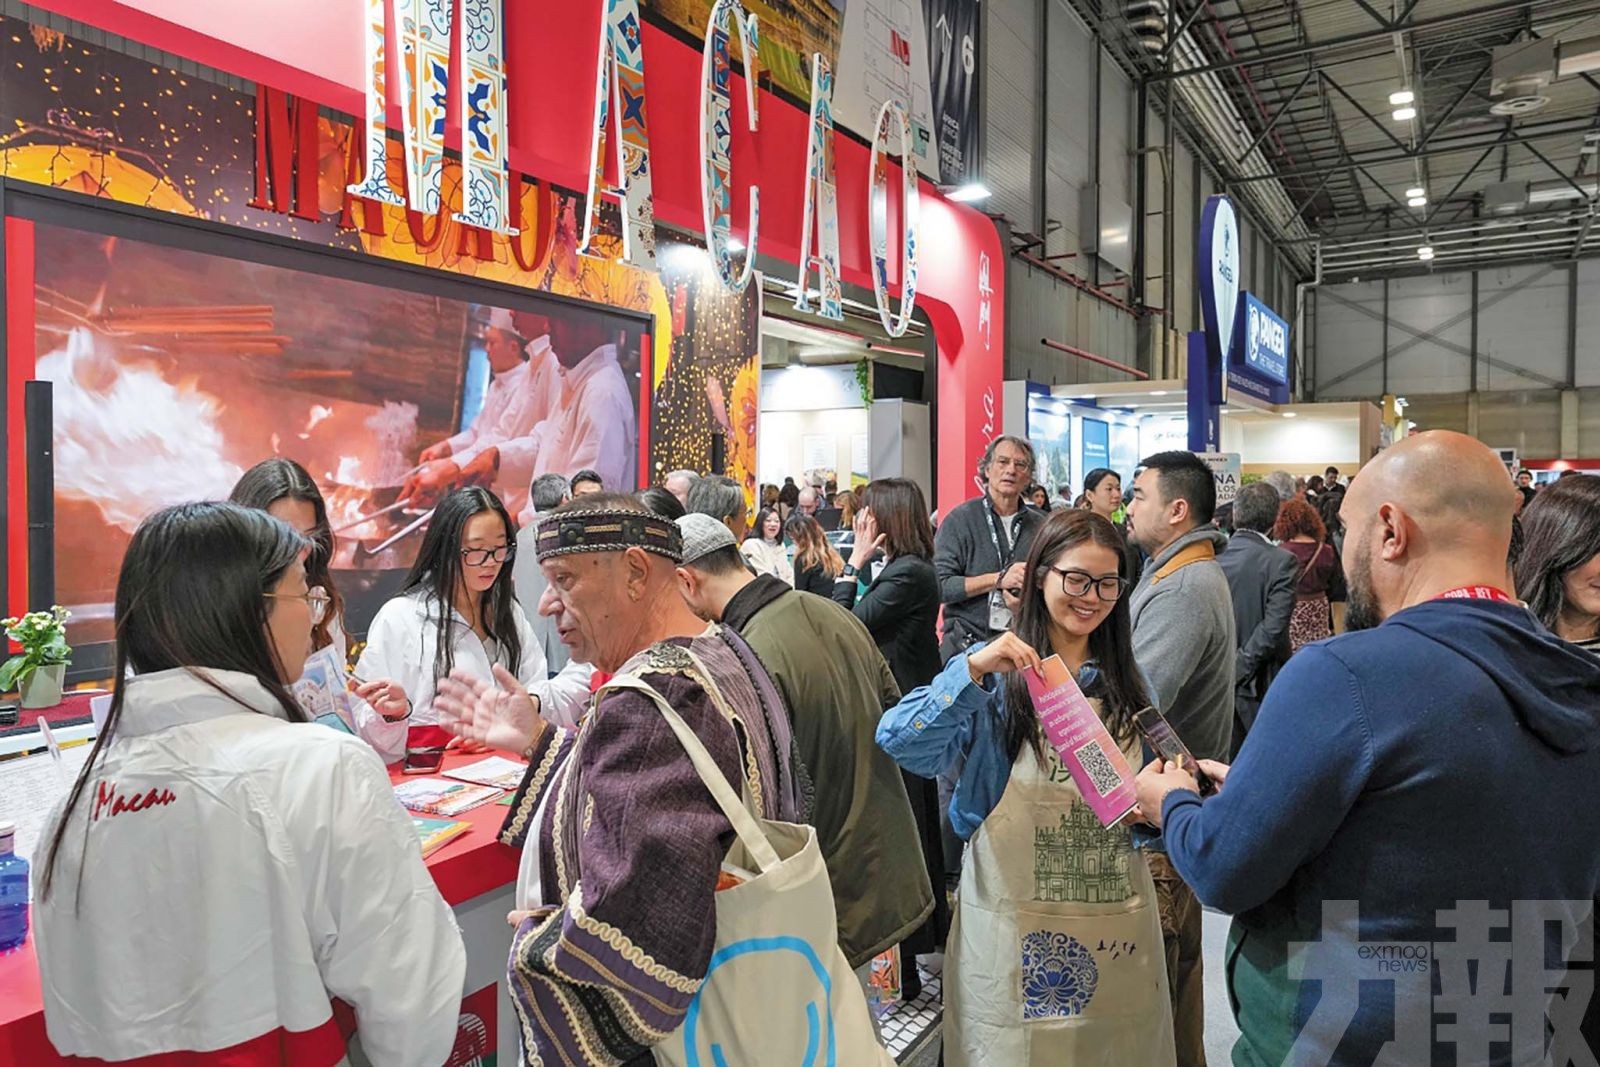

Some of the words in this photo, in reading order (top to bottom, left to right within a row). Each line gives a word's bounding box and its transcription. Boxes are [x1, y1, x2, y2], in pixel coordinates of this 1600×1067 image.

[962, 34, 975, 75] 6
[346, 0, 920, 338] MACAO
[1260, 311, 1286, 359] PANGEA
